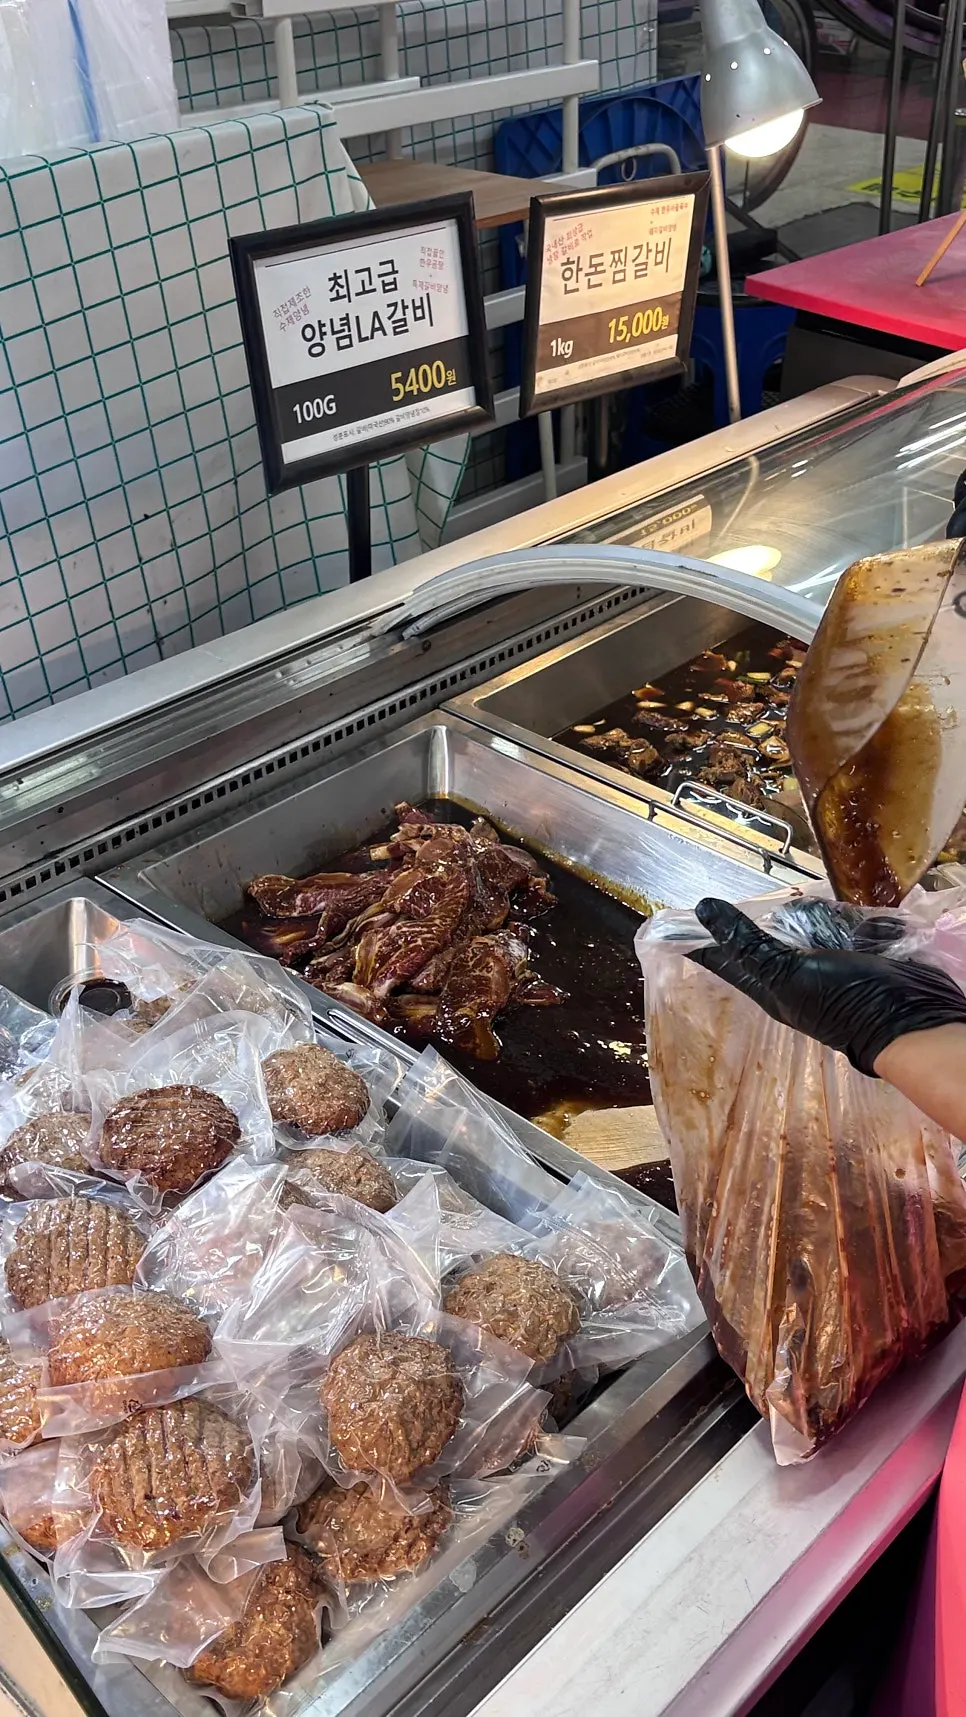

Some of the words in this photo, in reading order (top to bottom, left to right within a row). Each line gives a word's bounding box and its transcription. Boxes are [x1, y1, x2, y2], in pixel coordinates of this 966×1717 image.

[328, 259, 399, 303] 최고급
[561, 237, 672, 295] 한돈찜갈비
[273, 286, 312, 319] 직접제조한
[280, 303, 310, 332] 수제양념
[301, 293, 433, 358] 양념LA갈비
[550, 338, 574, 359] 1kg
[391, 360, 457, 402] 5400원
[293, 394, 337, 424] 100G
